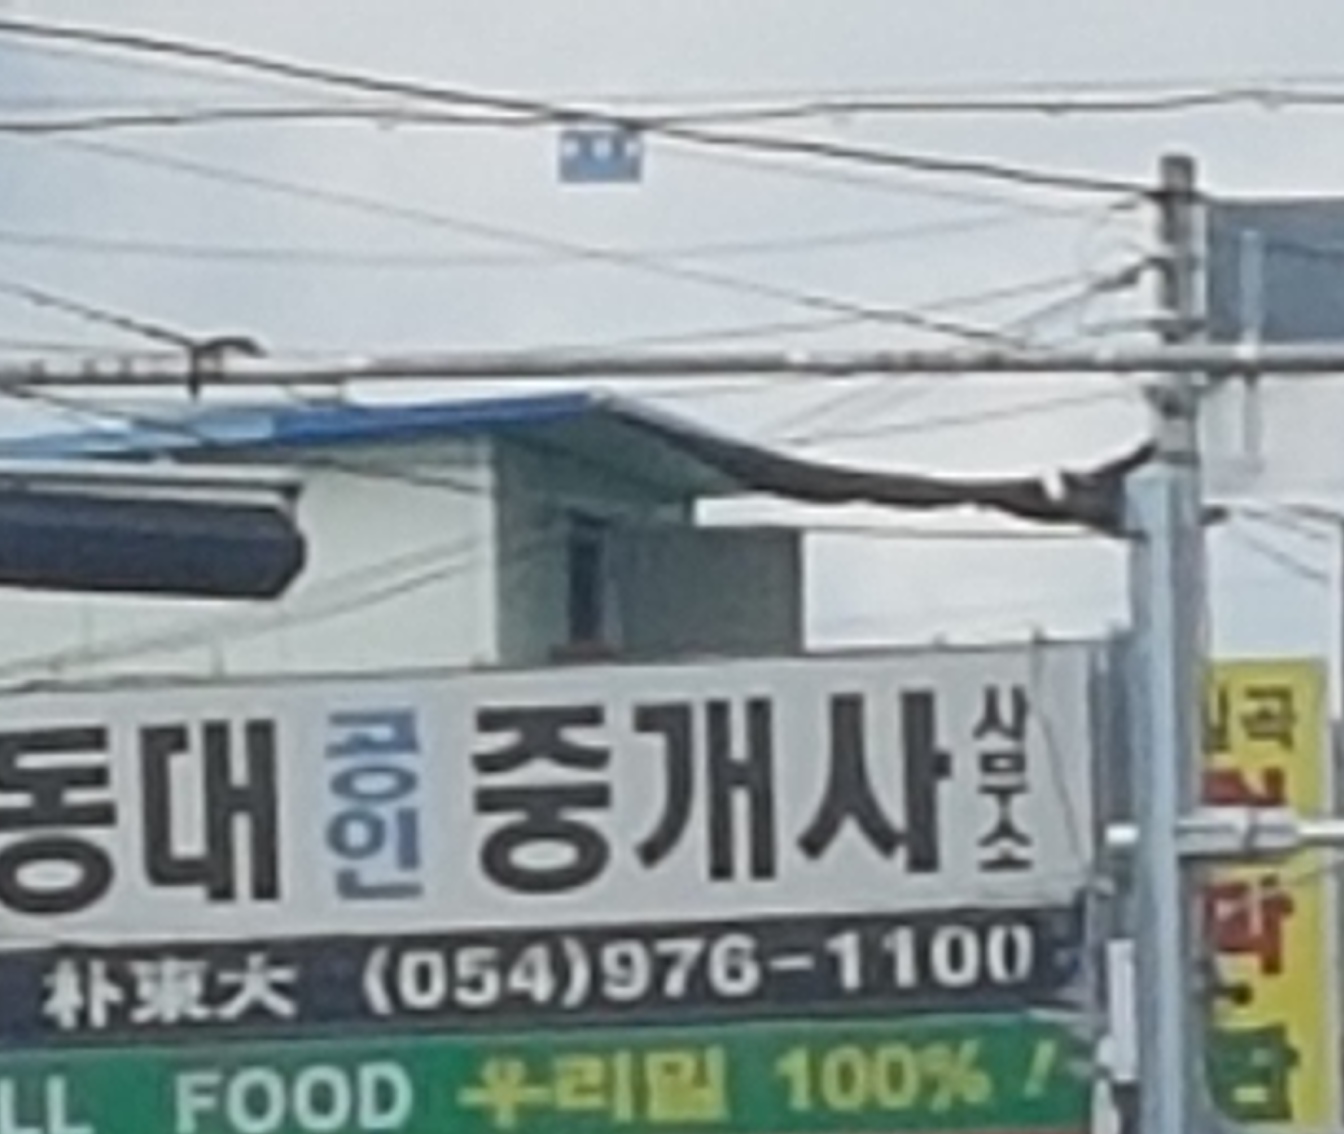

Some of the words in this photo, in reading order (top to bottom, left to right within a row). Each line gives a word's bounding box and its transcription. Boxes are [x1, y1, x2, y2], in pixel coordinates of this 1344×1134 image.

[325, 708, 423, 900] 공인
[471, 690, 952, 894] 중개사
[973, 686, 1034, 871] 사무소
[40, 952, 299, 1030] 朴東大
[362, 923, 1034, 1016] (054)976-1100
[460, 1046, 729, 1130] 우리밀
[773, 1039, 992, 1113] 100%
